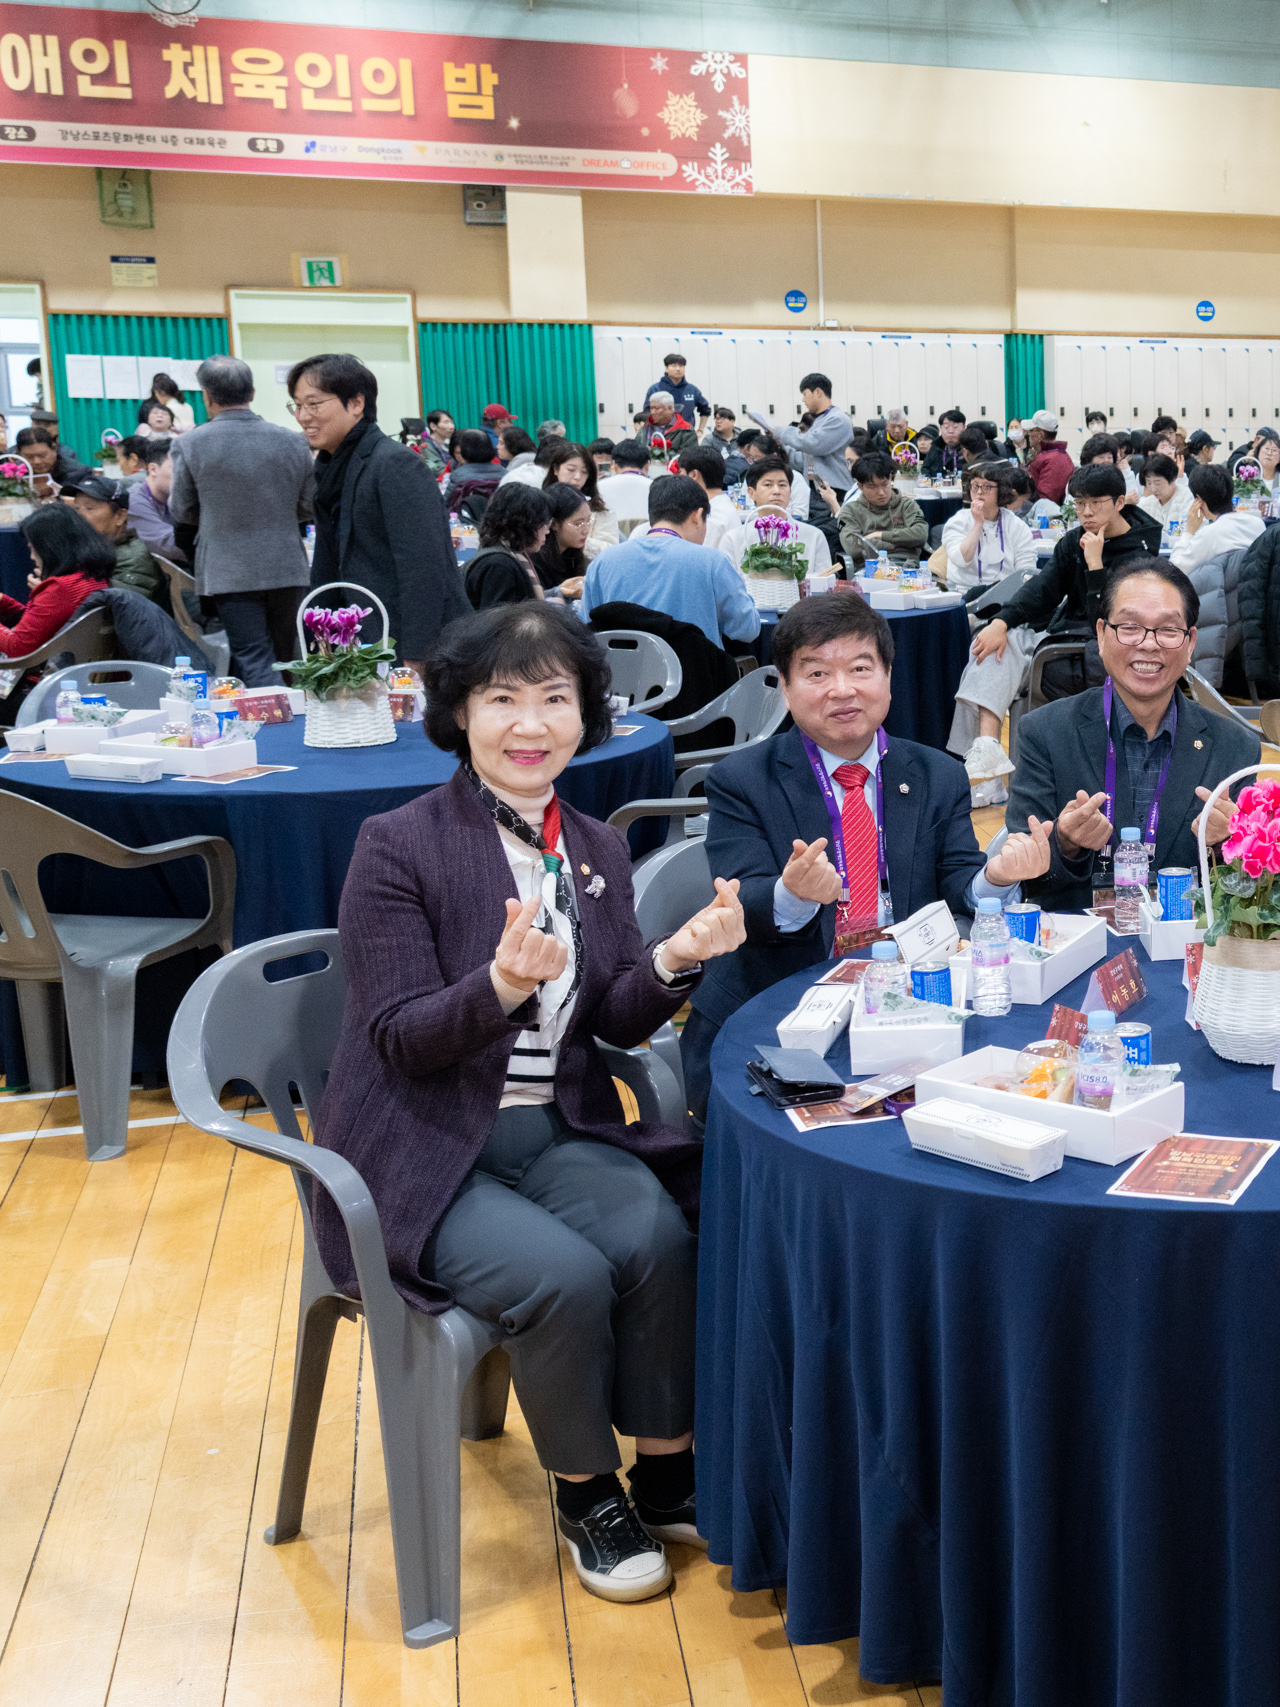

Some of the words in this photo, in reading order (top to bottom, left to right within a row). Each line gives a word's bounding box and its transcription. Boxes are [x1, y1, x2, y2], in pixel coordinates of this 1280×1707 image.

[0, 33, 132, 99] 애인
[162, 43, 415, 115] 체육인의
[442, 62, 499, 120] 밤
[4, 126, 28, 140] 장소
[59, 129, 156, 144] 강남스포츠문화센터
[255, 138, 278, 153] 후원
[434, 147, 489, 159] PARNAS
[582, 157, 620, 169] DREAM
[632, 160, 668, 171] OFFICE
